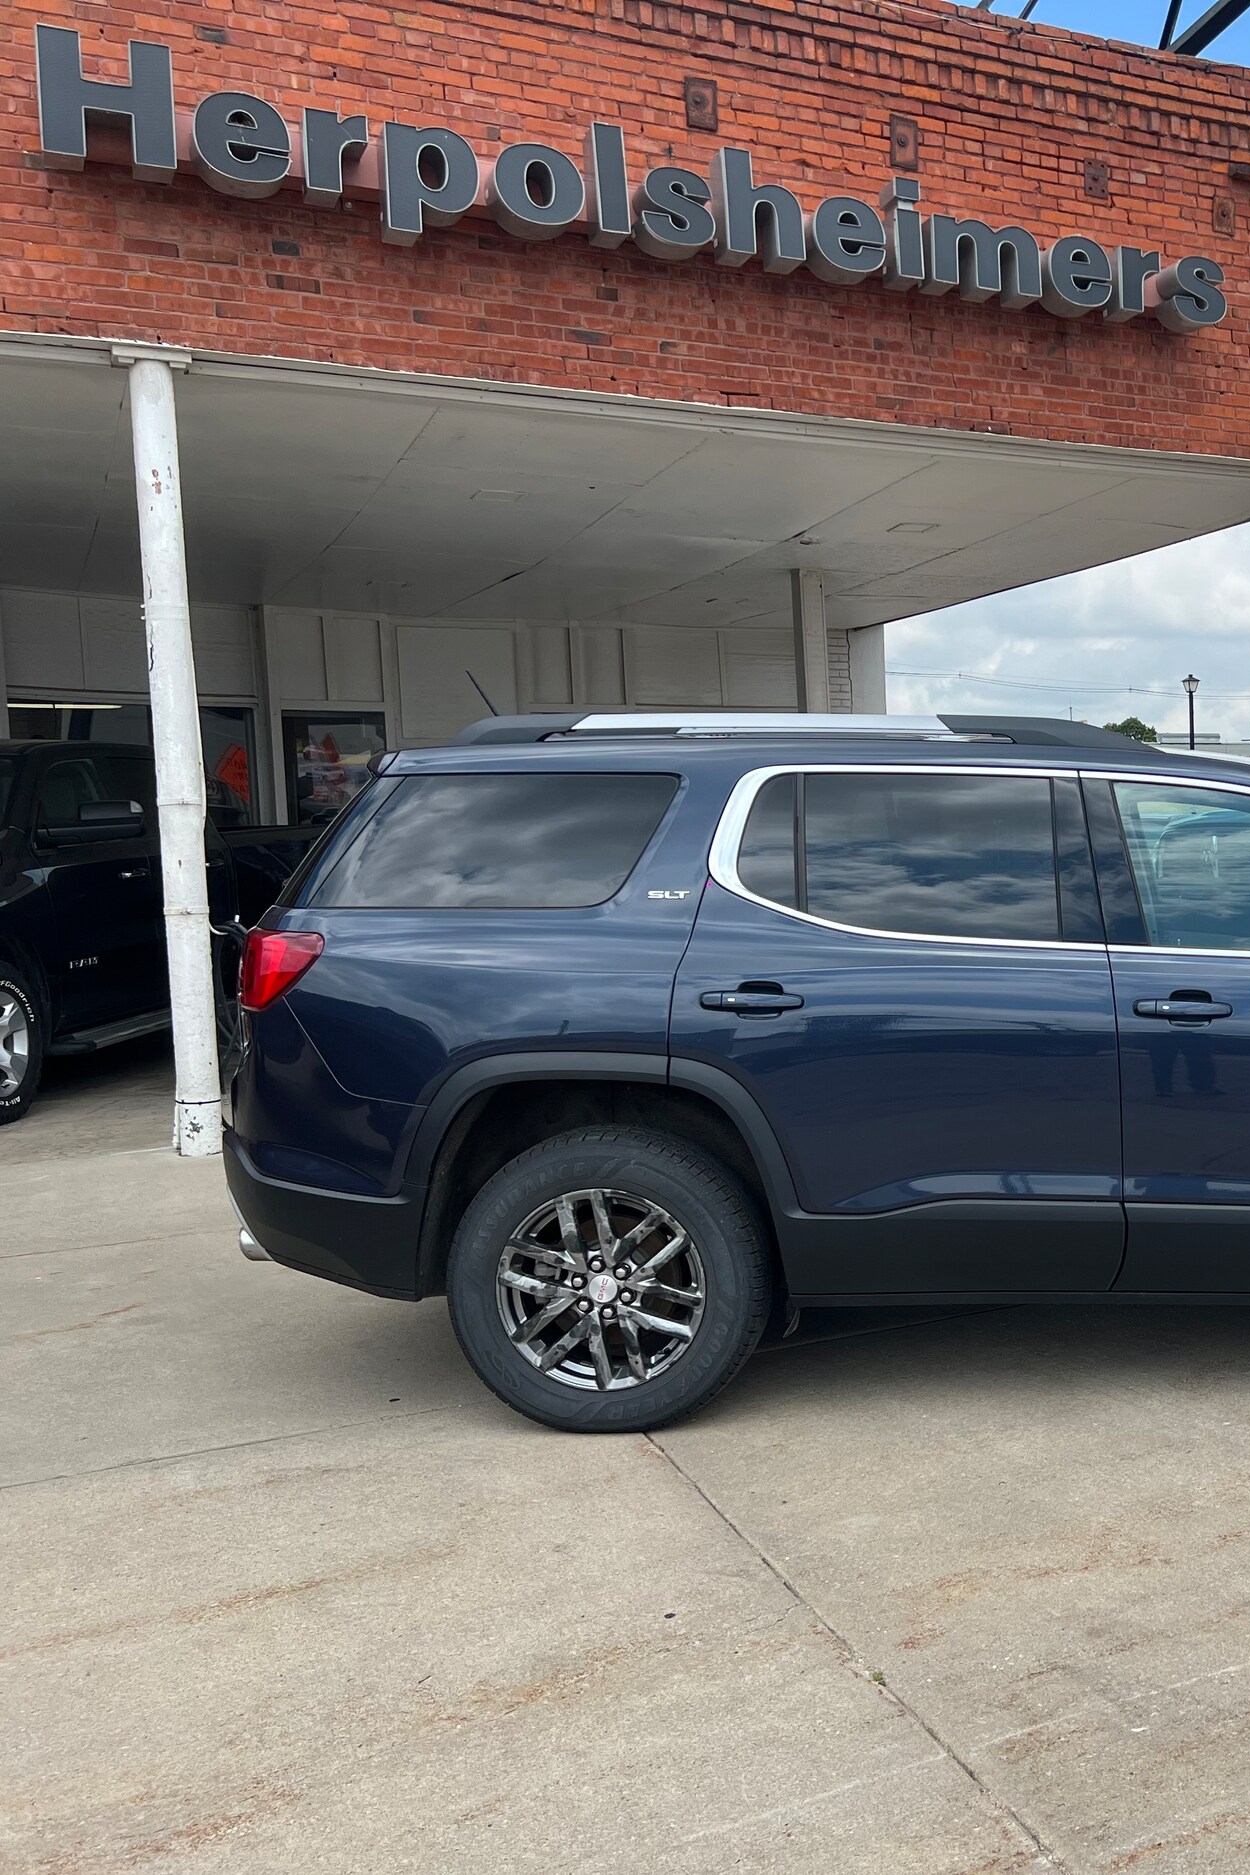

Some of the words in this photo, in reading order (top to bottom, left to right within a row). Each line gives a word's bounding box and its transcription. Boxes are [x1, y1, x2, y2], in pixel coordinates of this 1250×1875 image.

[35, 23, 1227, 332] Herpolsheimers
[647, 890, 690, 899] SLT
[0, 980, 35, 1022] FGoodrich
[472, 1161, 587, 1258] ASSURANCE
[597, 1277, 609, 1301] GMC
